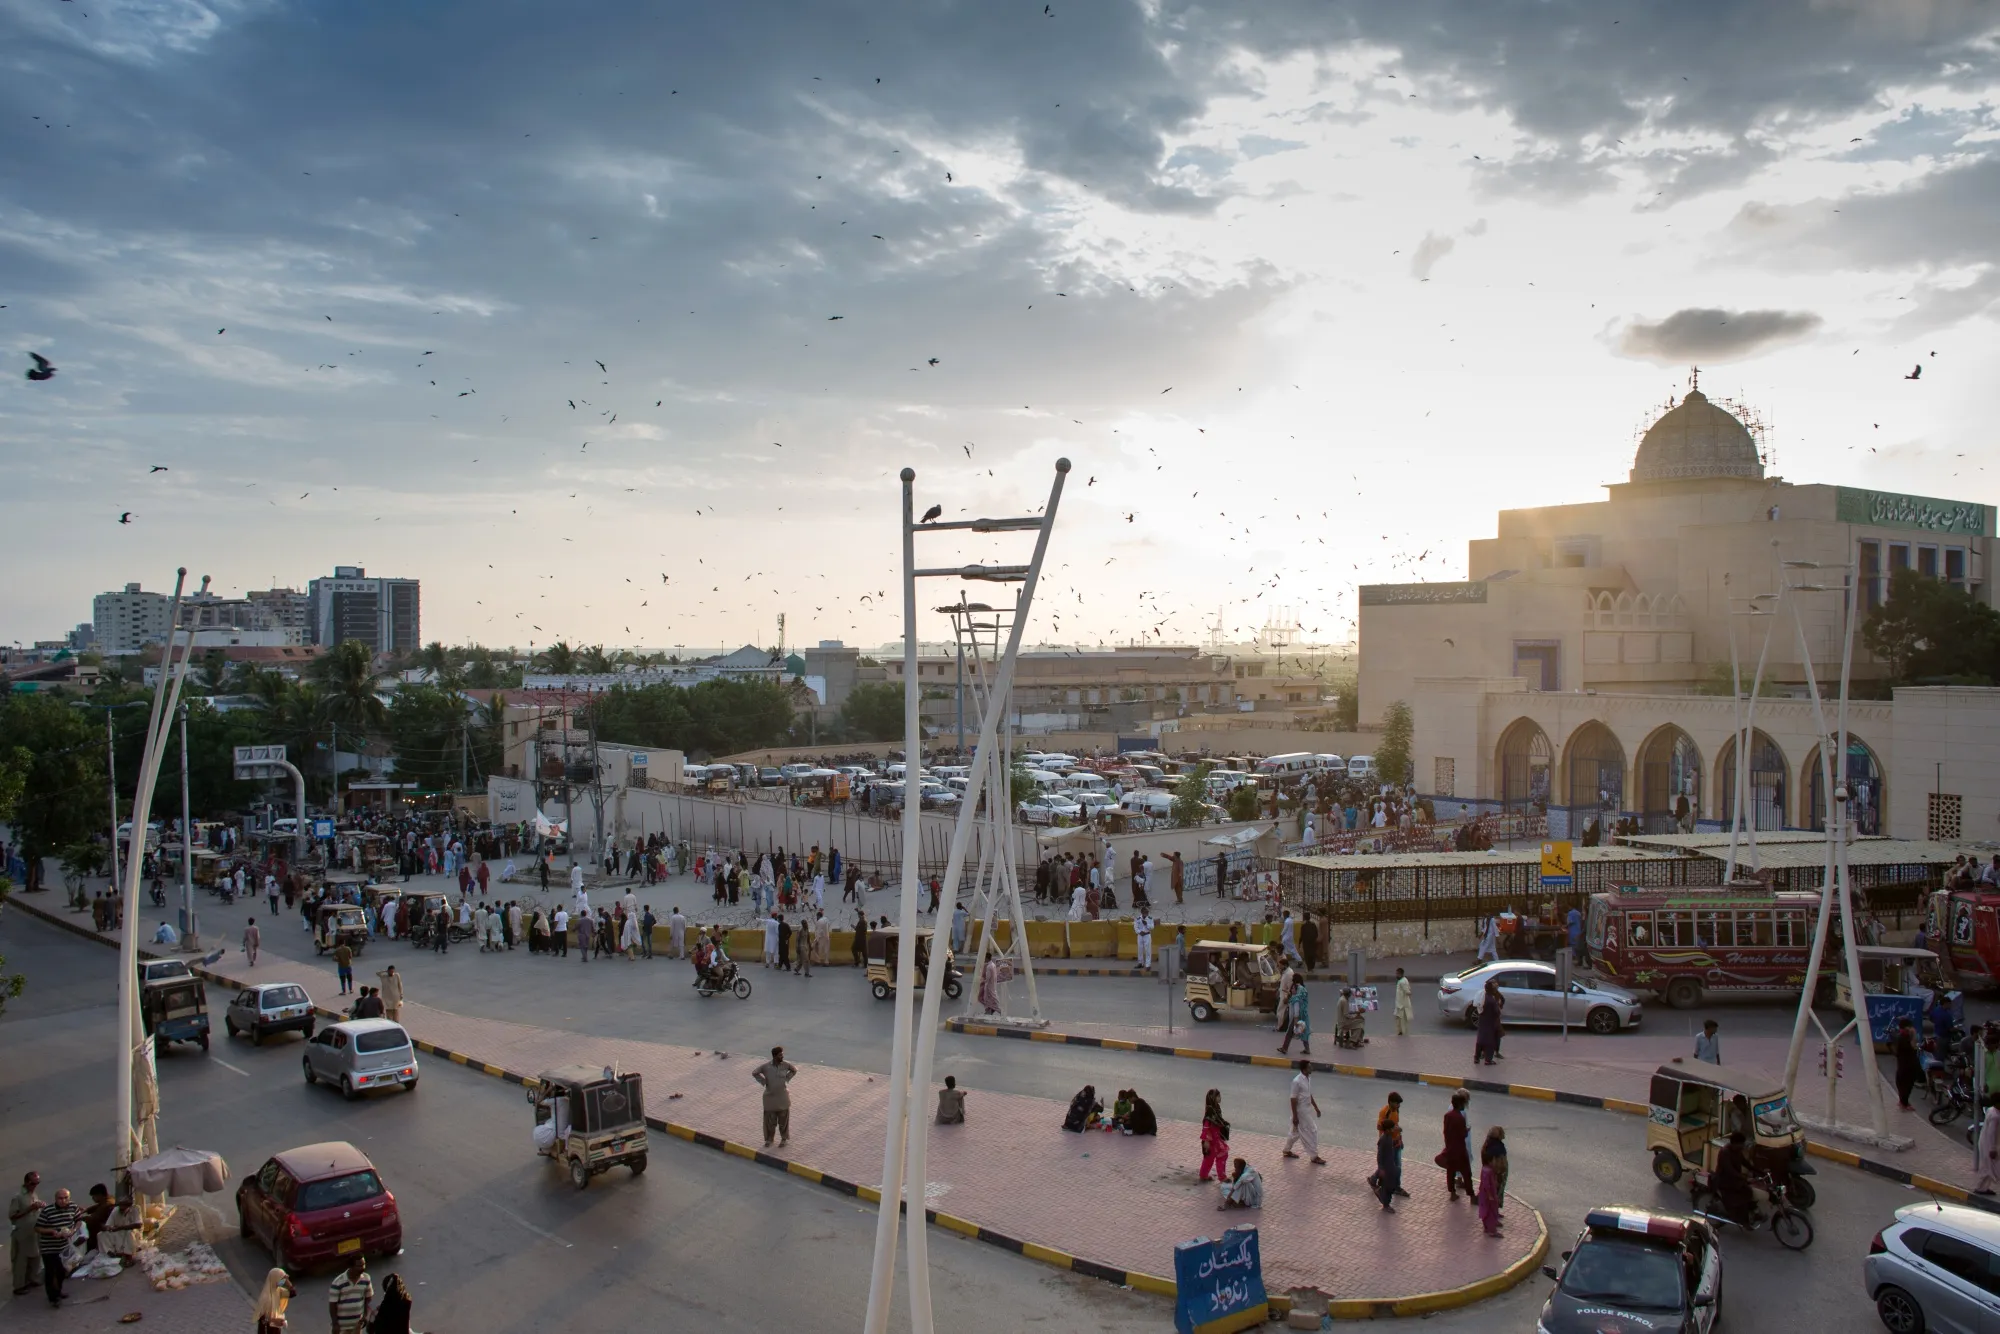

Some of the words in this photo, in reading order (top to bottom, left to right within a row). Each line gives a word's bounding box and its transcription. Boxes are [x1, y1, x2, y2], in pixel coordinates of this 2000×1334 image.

[1942, 507, 1966, 532] حضرت
[1199, 1234, 1253, 1276] پاکستان
[1617, 1311, 1655, 1329] PATROL
